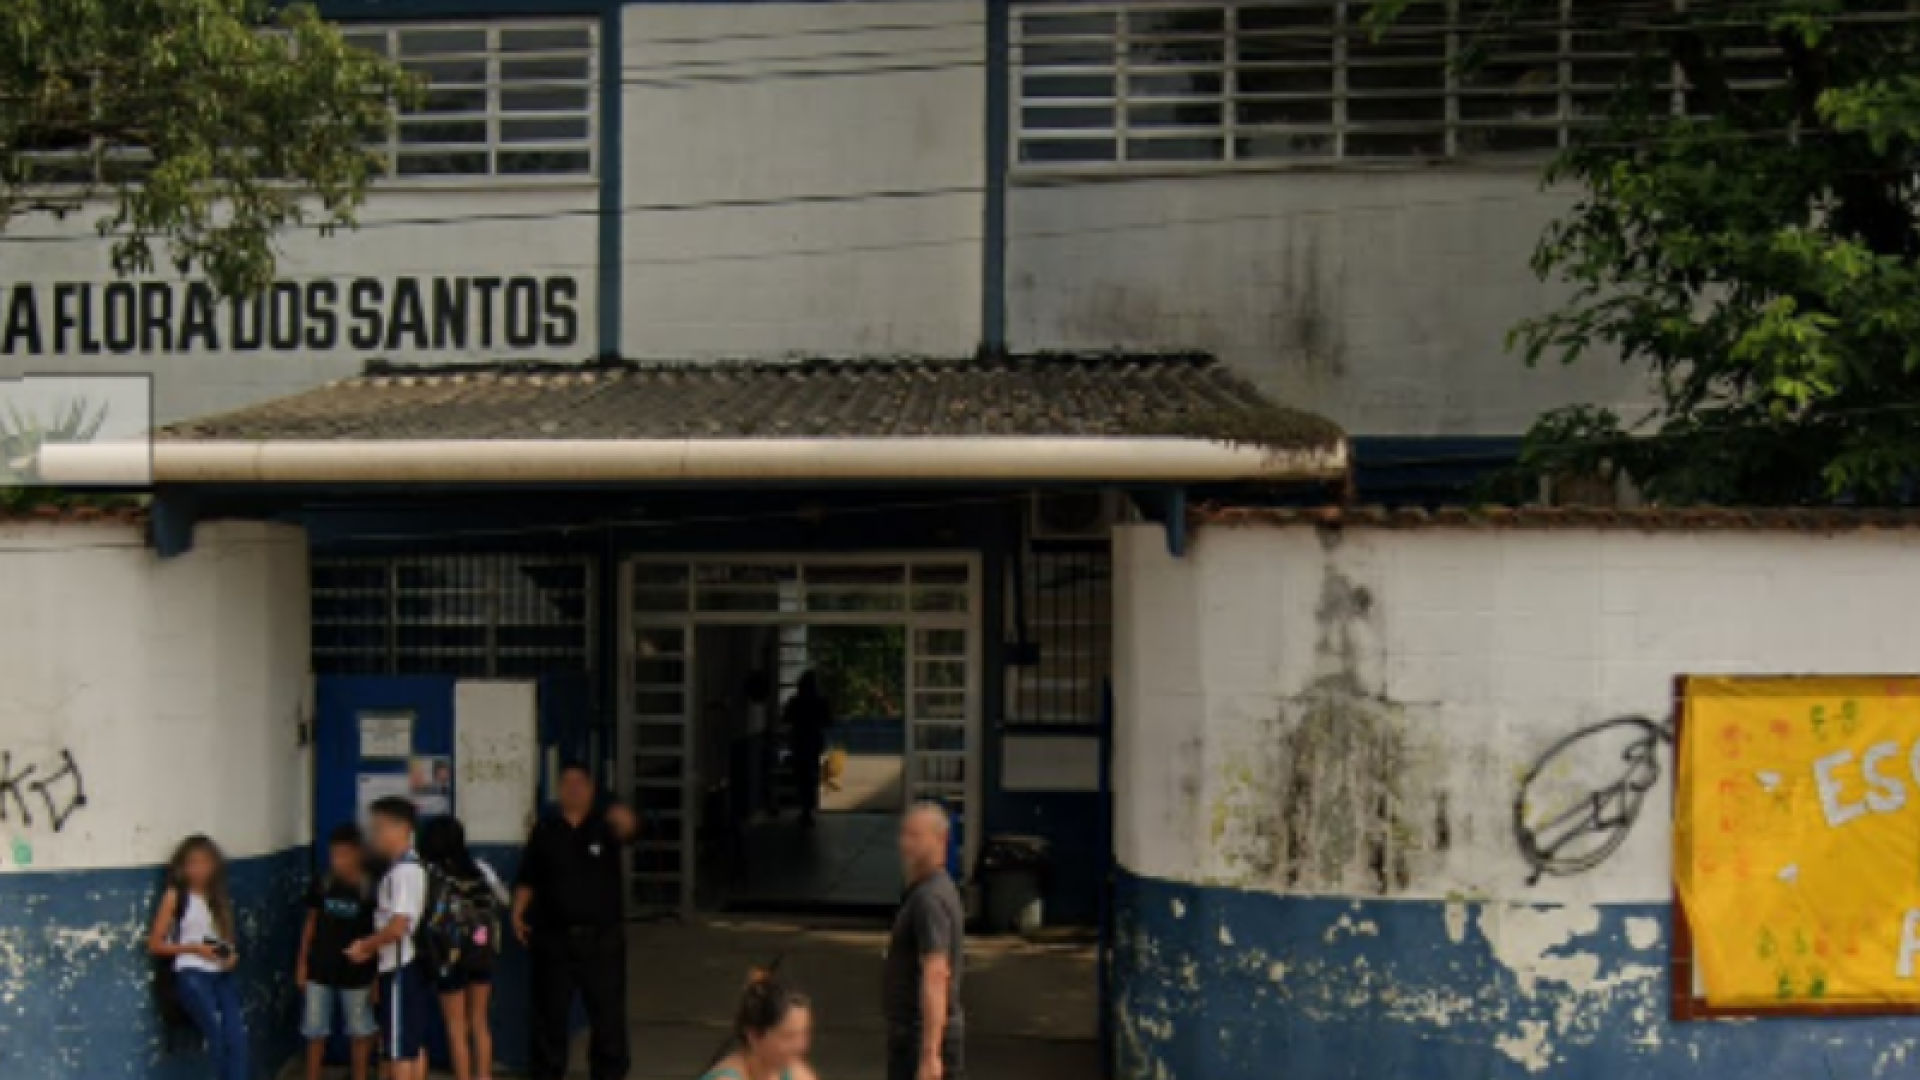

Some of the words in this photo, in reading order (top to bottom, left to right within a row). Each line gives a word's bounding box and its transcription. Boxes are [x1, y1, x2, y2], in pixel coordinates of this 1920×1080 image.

[53, 281, 220, 354] FLORA
[231, 280, 338, 351] DOS
[347, 276, 578, 351] SANTOS
